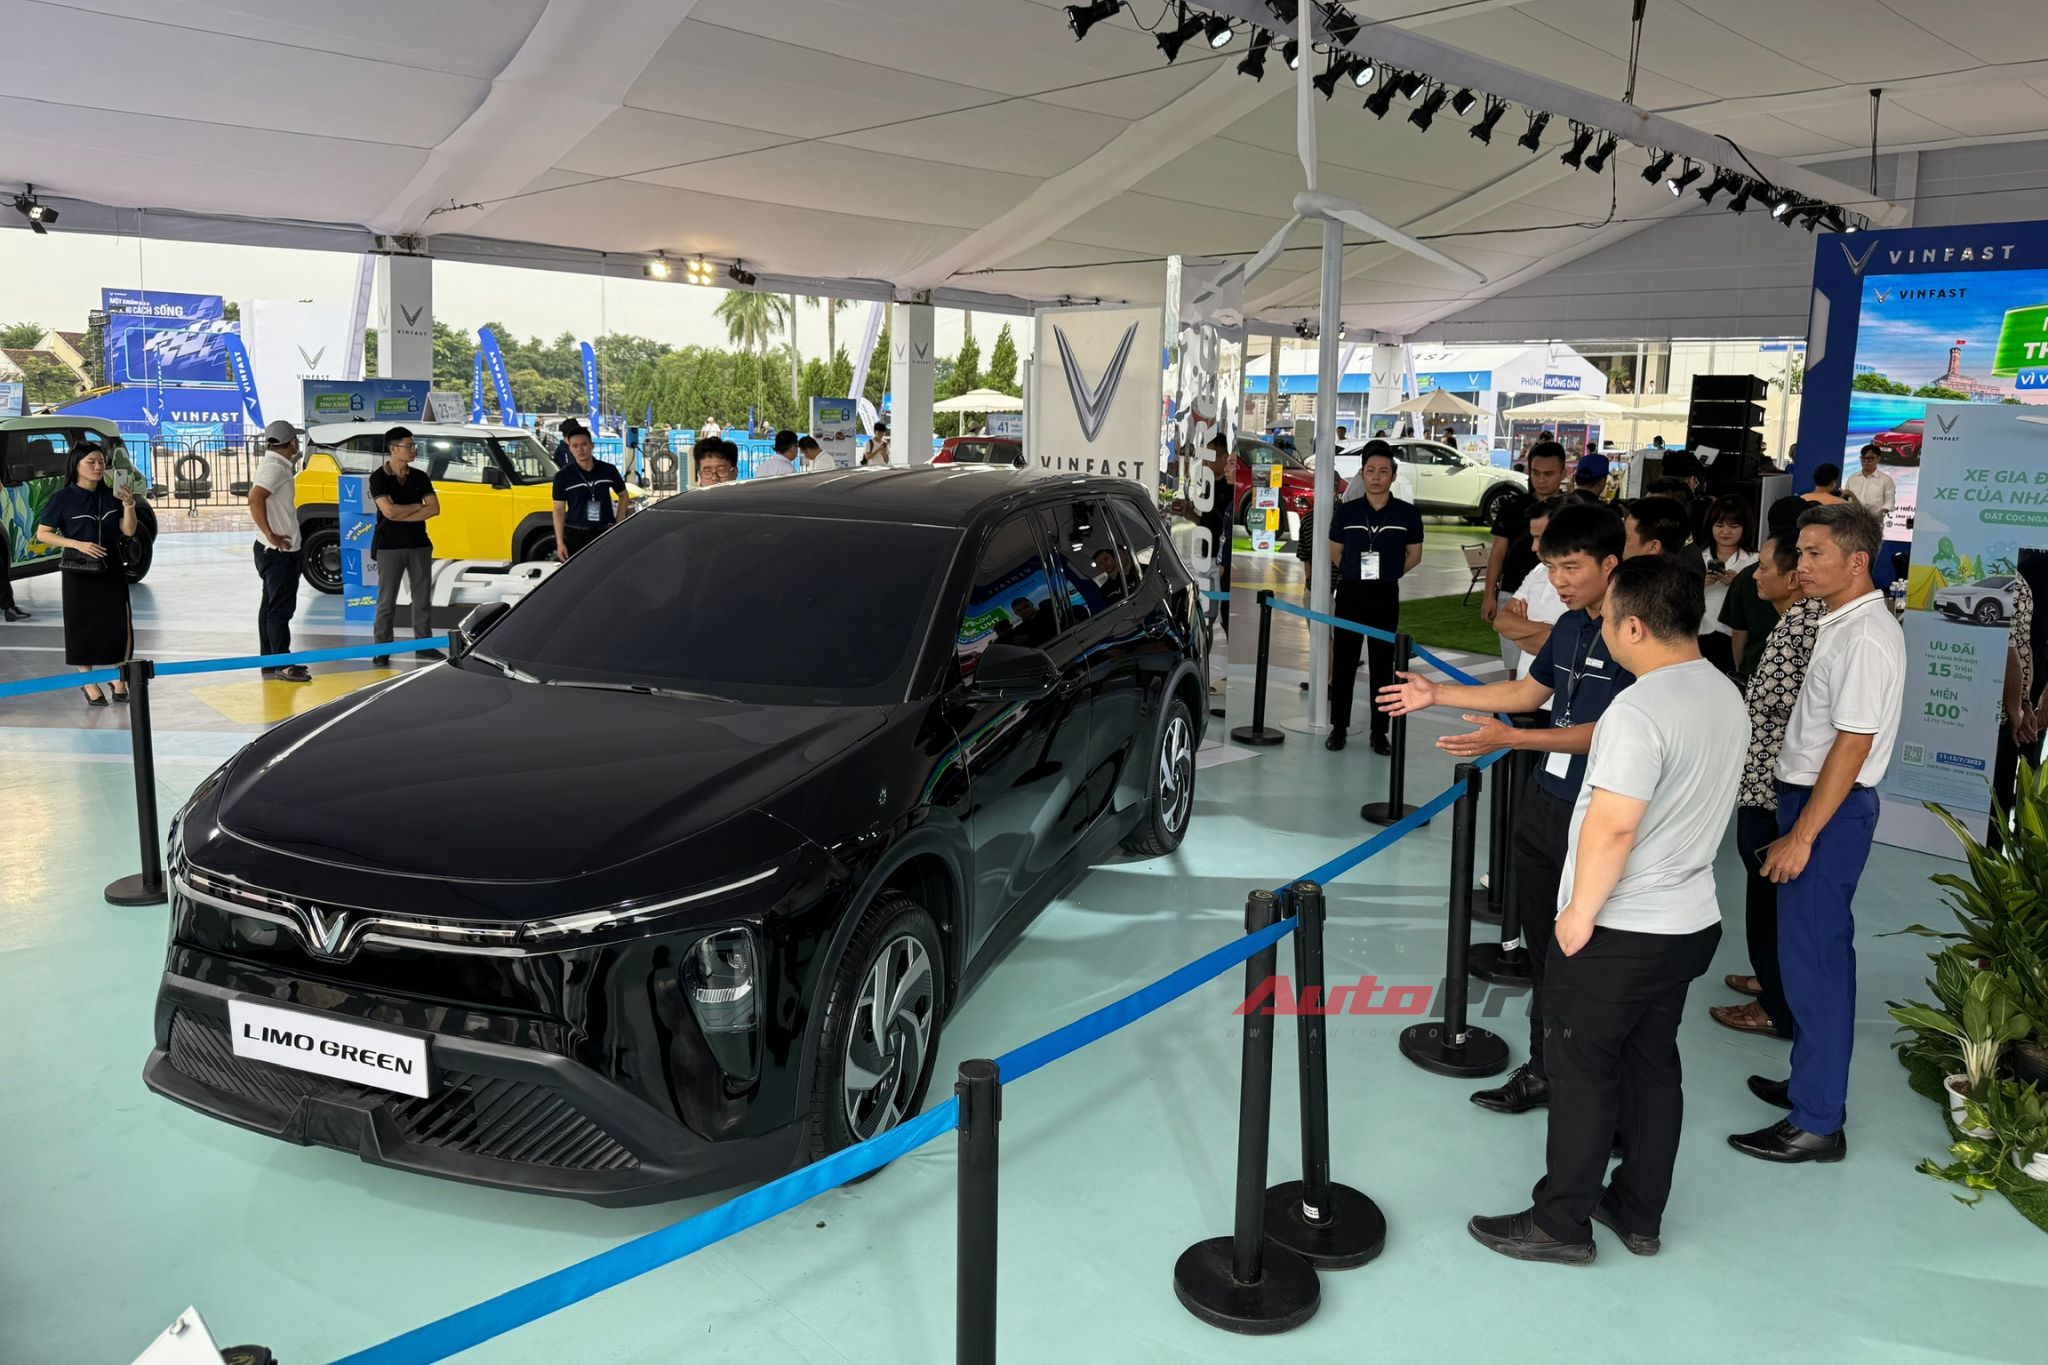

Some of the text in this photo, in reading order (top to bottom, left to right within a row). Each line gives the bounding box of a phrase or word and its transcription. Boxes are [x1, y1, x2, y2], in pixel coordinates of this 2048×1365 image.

[1889, 245, 2015, 265] VINFAST
[1899, 288, 1967, 300] VINFAST
[153, 303, 184, 317] SỐNG
[171, 410, 240, 423] VINFAST
[997, 421, 1009, 433] 41
[1040, 455, 1145, 480] VINFAST
[1963, 468, 1990, 483] XE
[1994, 470, 2029, 485] GIA
[1933, 486, 1960, 501] XE
[1963, 485, 2004, 504] CỦA
[1984, 511, 2004, 524] ĐẶT
[2005, 513, 2025, 524] CỌC
[1929, 640, 1975, 656] ƯU ĐÃI
[1927, 662, 1952, 678] 15
[1923, 702, 1960, 720] 100
[243, 1023, 413, 1076] LIMO GREEN
